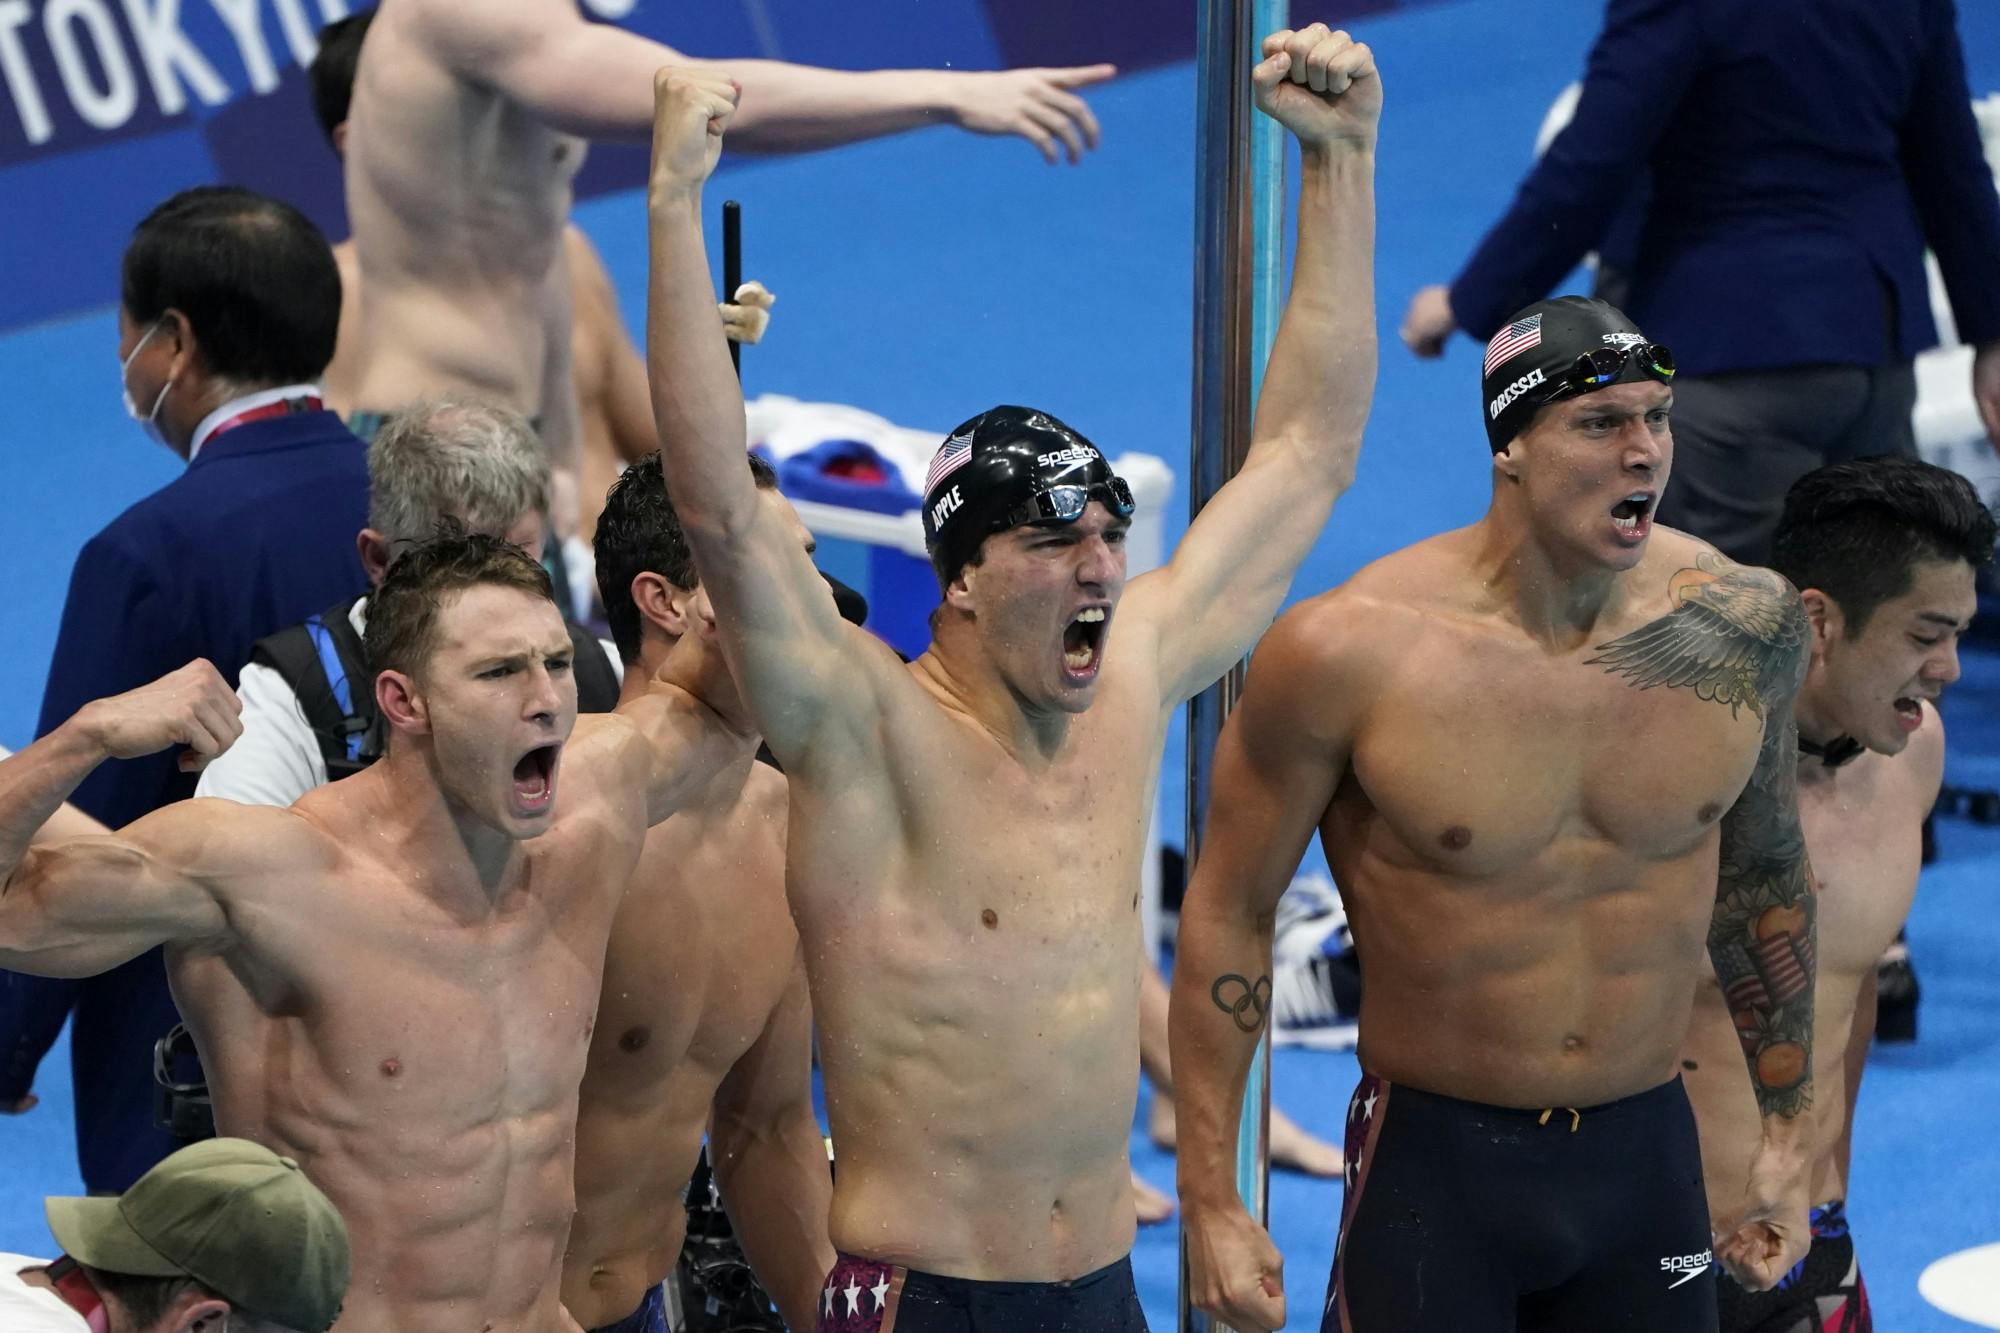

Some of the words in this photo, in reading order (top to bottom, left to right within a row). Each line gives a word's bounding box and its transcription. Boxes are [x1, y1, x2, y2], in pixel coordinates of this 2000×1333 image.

[1489, 367, 1548, 420] DRESSEL
[1036, 445, 1100, 468] speedo
[930, 485, 965, 532] APPLE
[1660, 1248, 1713, 1273] speedo
